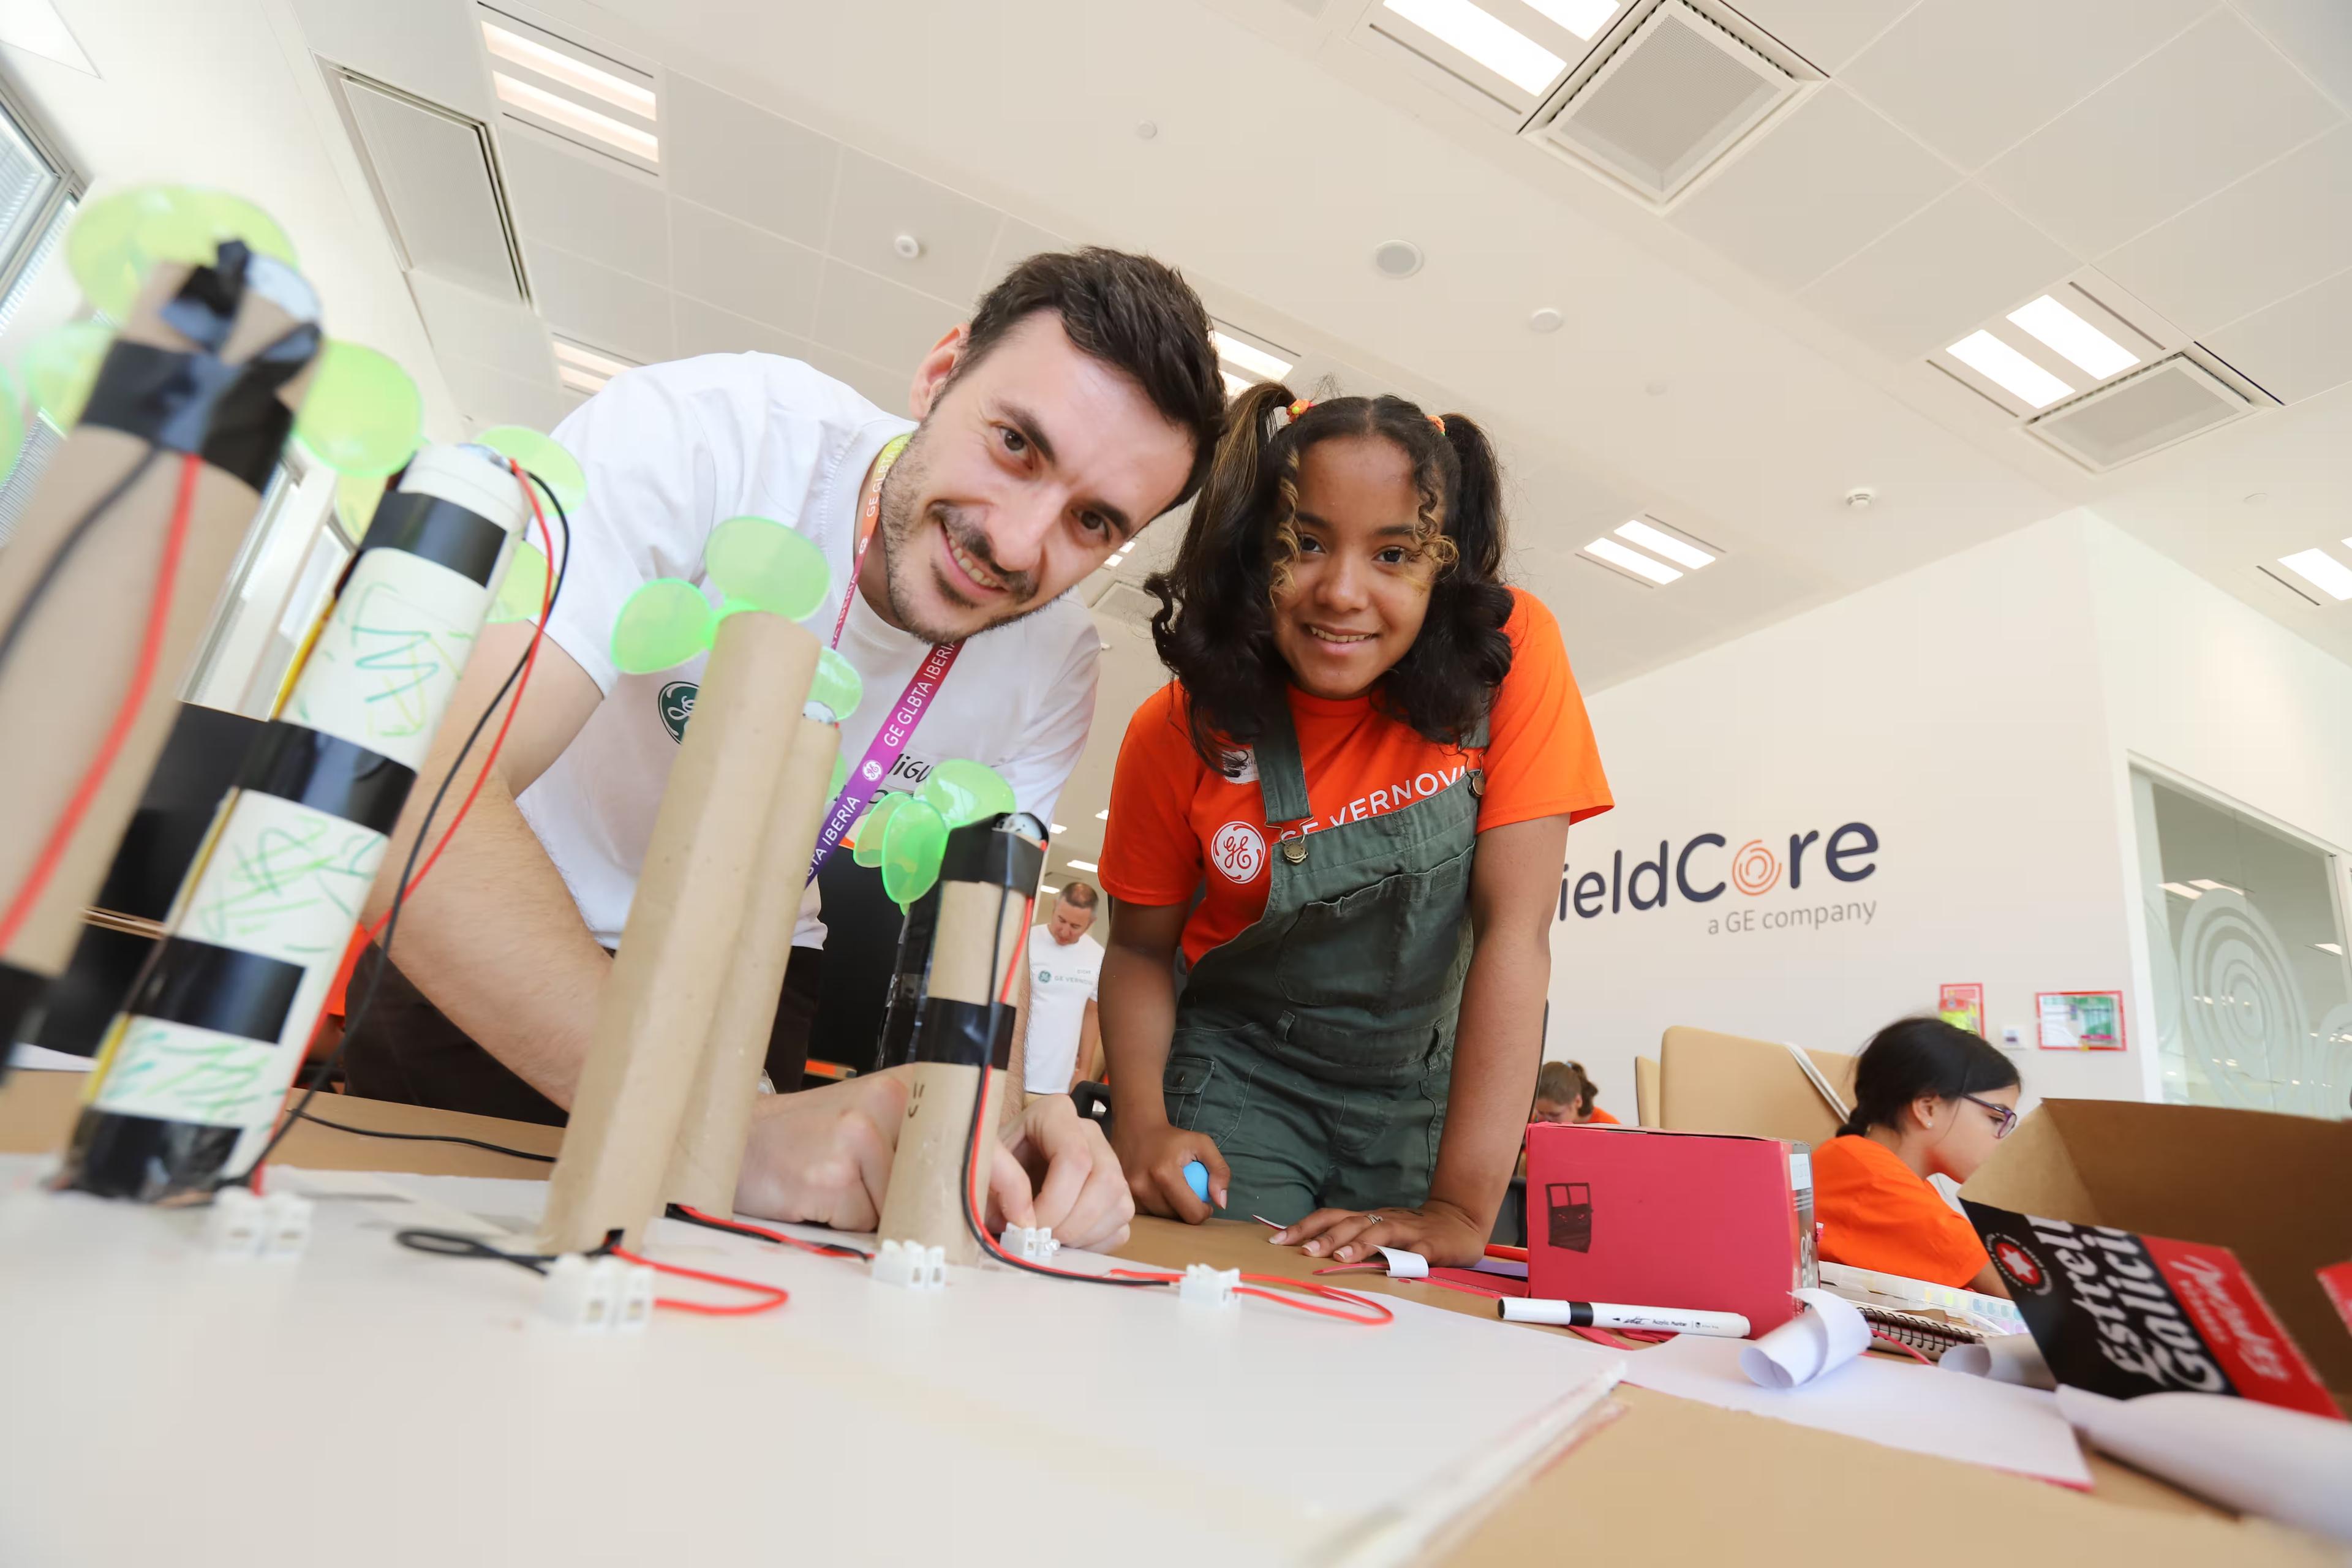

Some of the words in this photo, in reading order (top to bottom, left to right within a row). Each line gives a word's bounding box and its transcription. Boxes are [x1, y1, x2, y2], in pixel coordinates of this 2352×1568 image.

[884, 724, 905, 747] GE
[897, 681, 933, 725] GLBTA
[822, 797, 861, 846] IBERIA
[1559, 822, 1879, 921] ieldCore
[1708, 918, 1719, 935] a
[1725, 909, 1756, 933] GE
[1762, 900, 1877, 930] company
